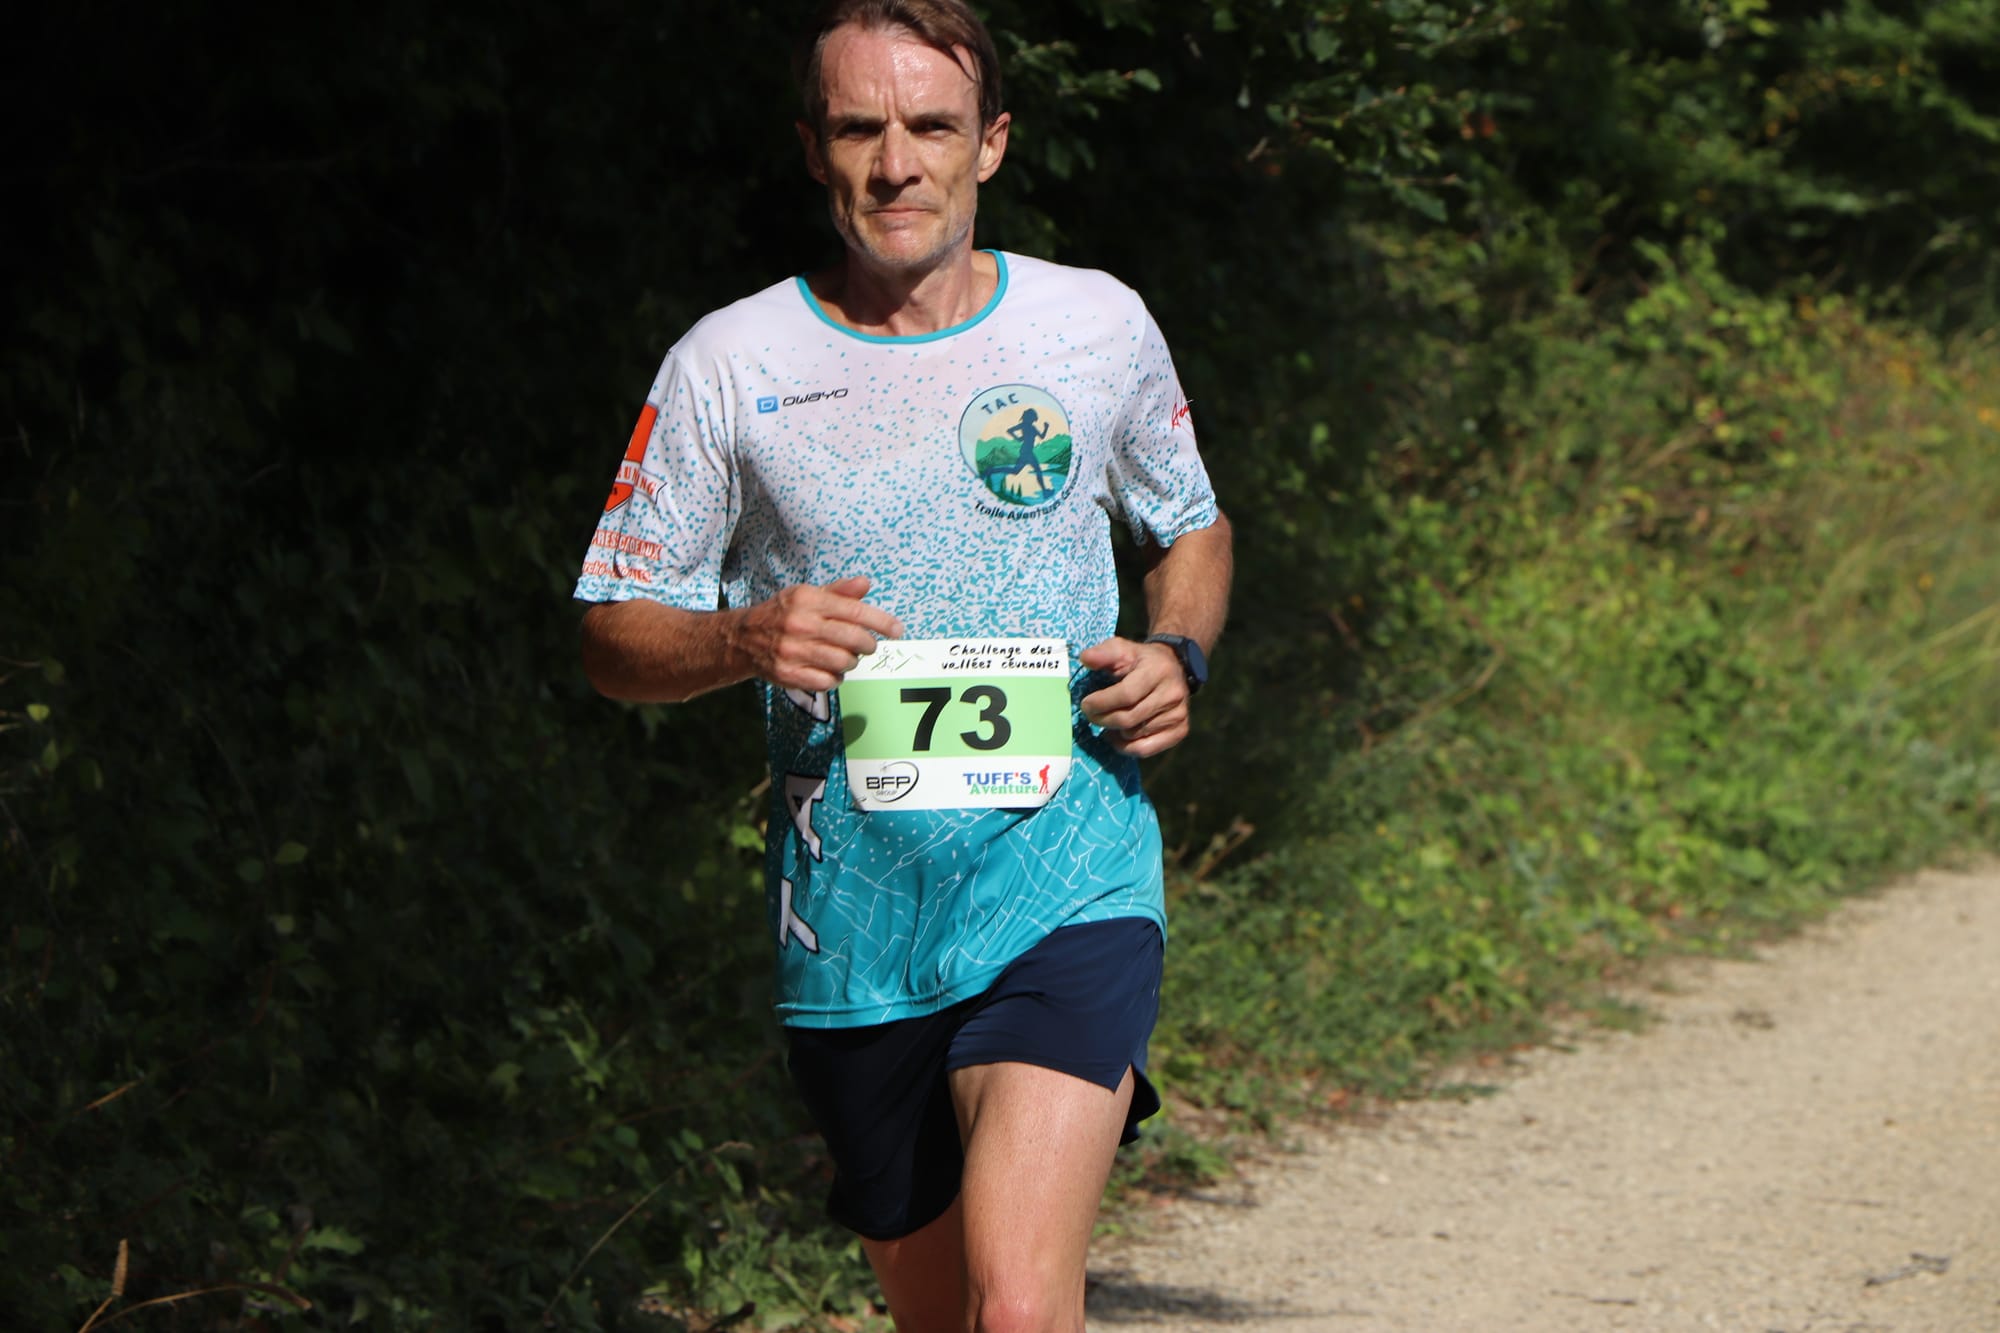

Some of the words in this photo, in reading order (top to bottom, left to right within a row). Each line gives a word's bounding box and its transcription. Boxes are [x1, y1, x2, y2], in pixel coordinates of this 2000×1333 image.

[980, 392, 1019, 415] TAC
[949, 644, 1022, 658] Challenge
[1030, 643, 1053, 655] des
[941, 657, 991, 669] vallées
[1000, 656, 1060, 669] cévenoles
[899, 684, 1012, 753] 73
[866, 776, 911, 790] BFP
[963, 772, 1032, 785] TUFF'S
[969, 783, 1039, 795] Aventure
